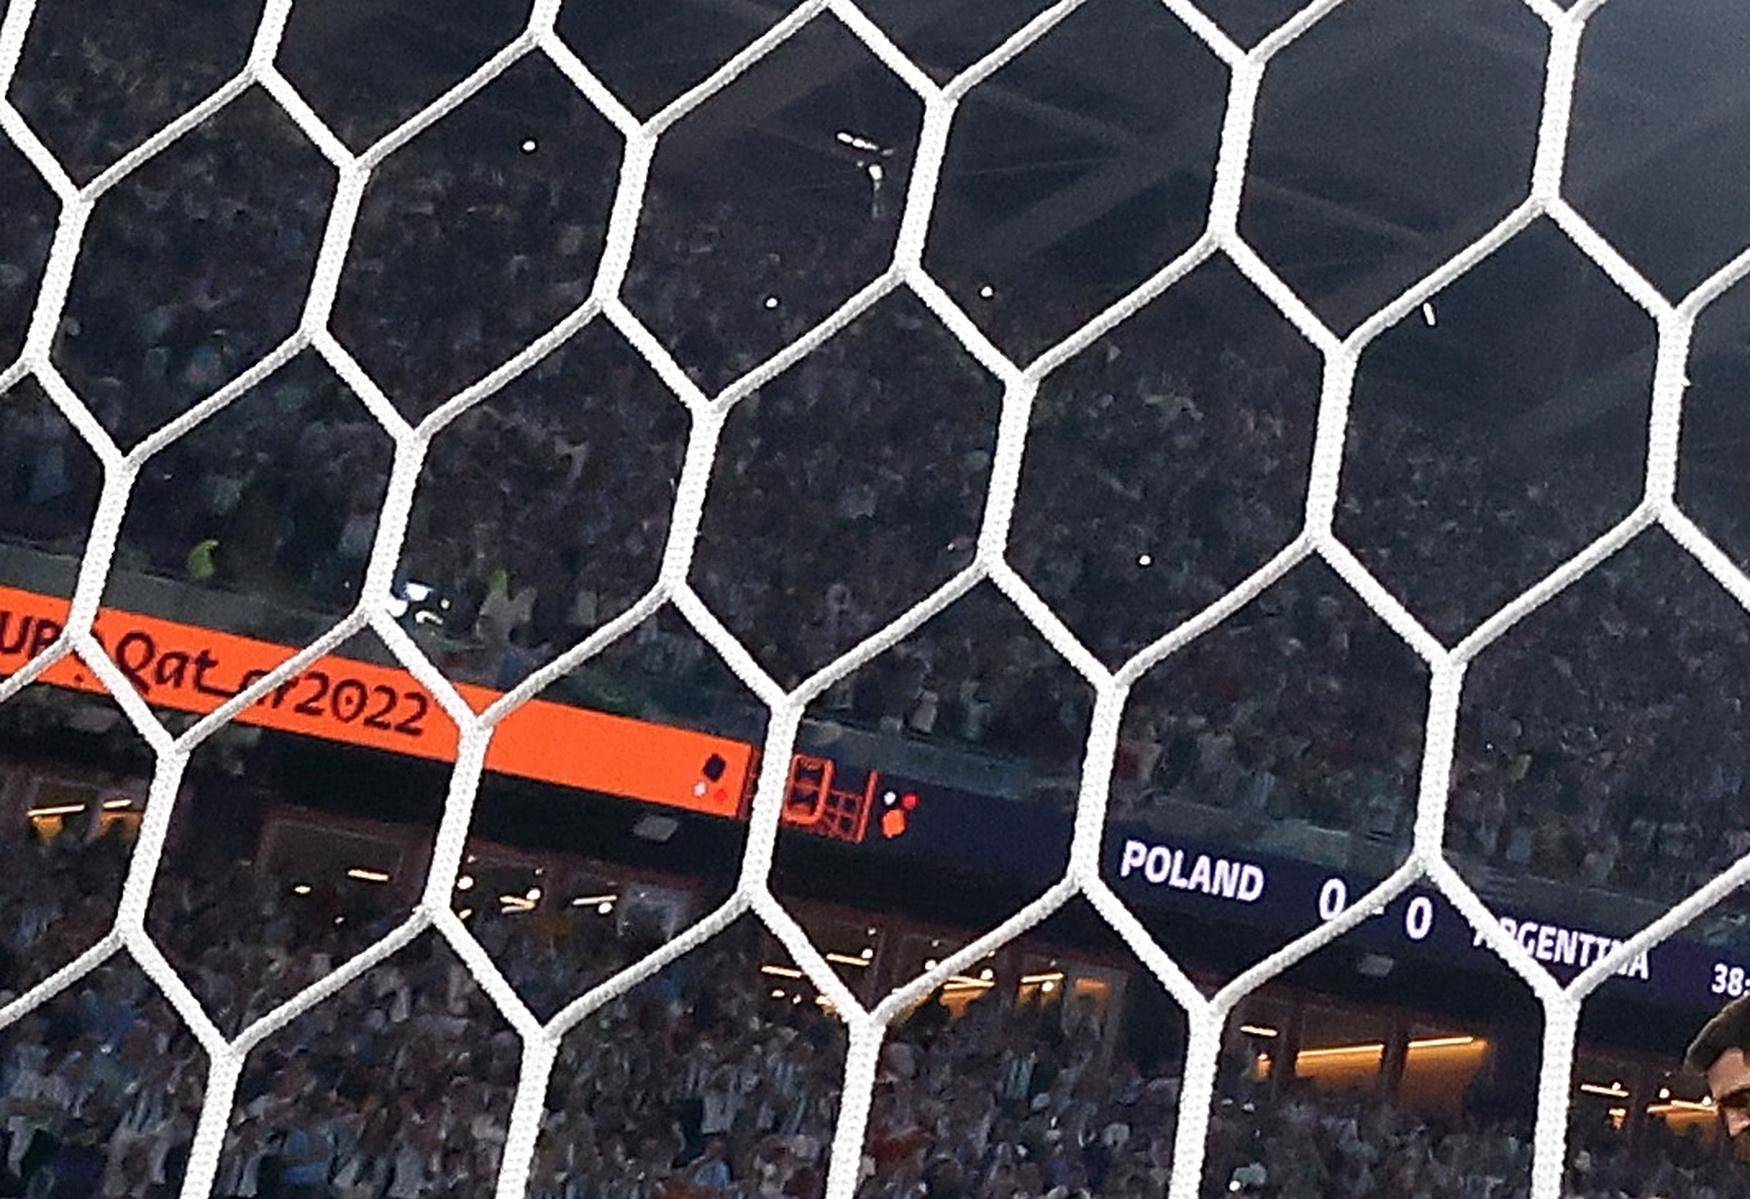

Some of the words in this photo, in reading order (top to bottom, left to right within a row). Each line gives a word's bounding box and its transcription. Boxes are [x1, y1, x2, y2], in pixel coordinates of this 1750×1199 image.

[1121, 840, 1264, 901] POLAND
[1319, 878, 1346, 921] 0
[1406, 897, 1433, 939] 0
